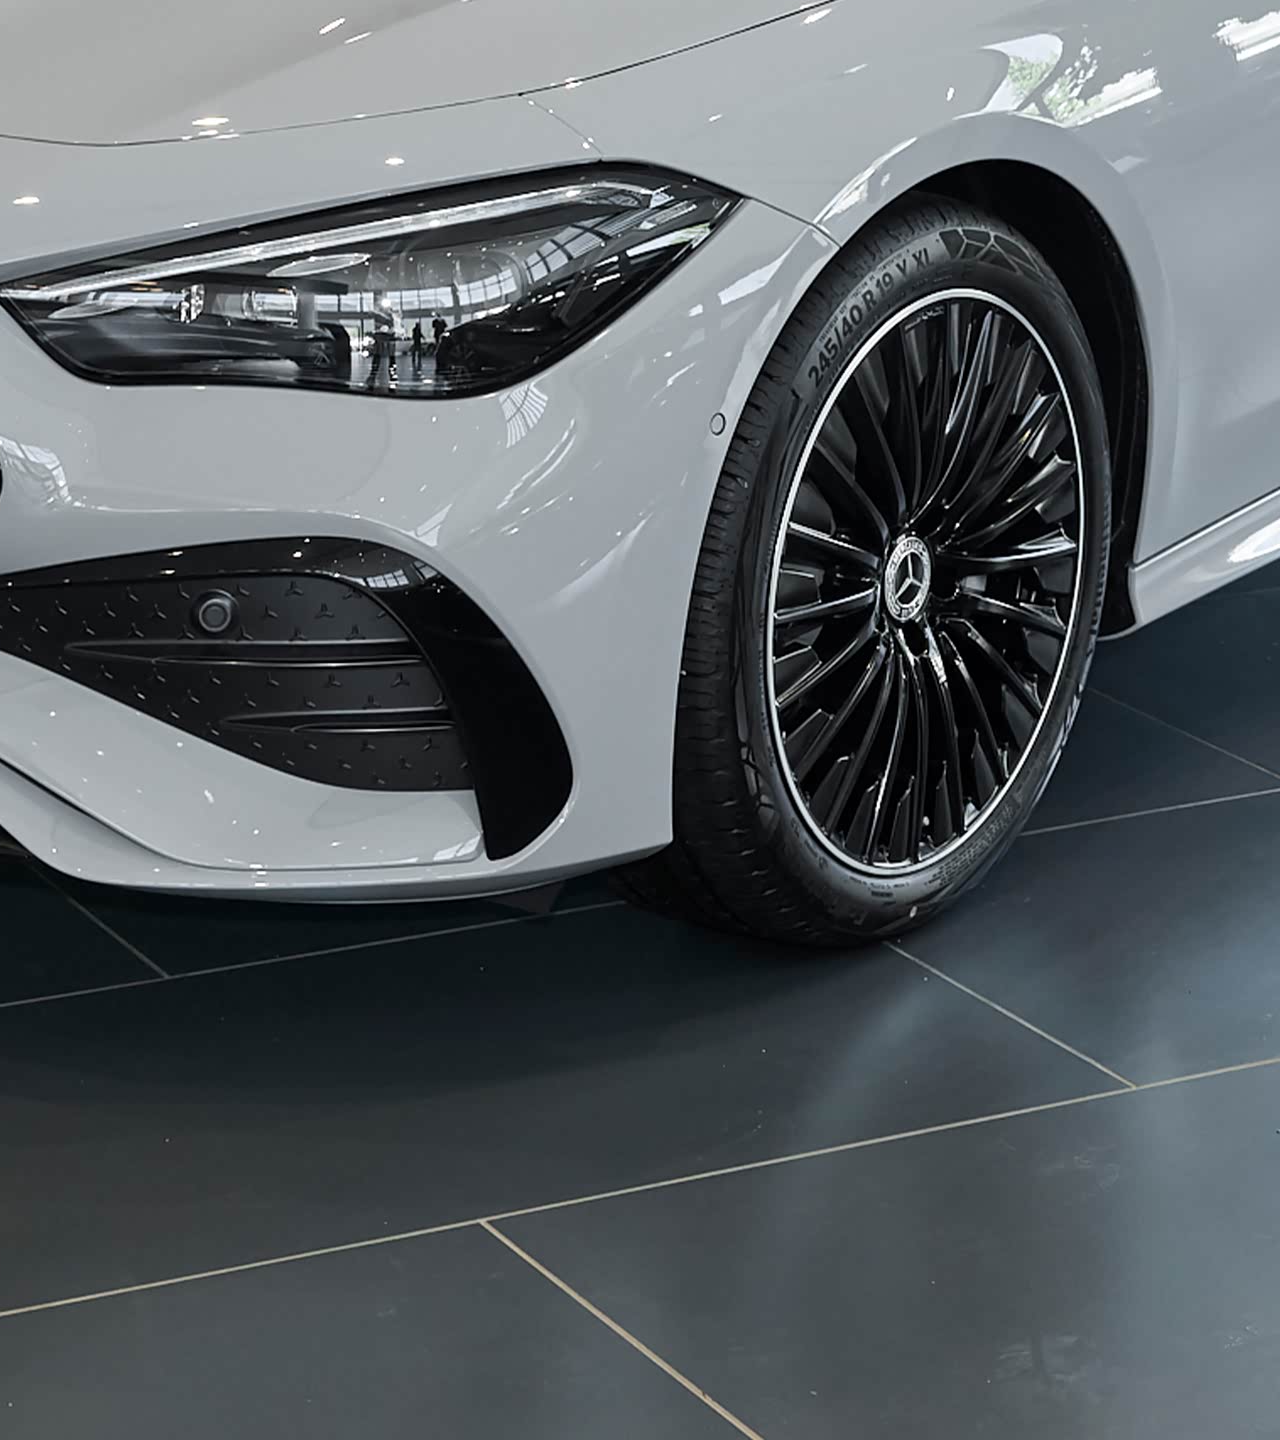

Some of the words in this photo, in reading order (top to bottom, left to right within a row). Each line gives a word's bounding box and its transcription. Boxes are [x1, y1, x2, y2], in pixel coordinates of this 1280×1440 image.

[808, 304, 864, 388] 245/40
[861, 288, 877, 312] R
[875, 271, 894, 297] 19
